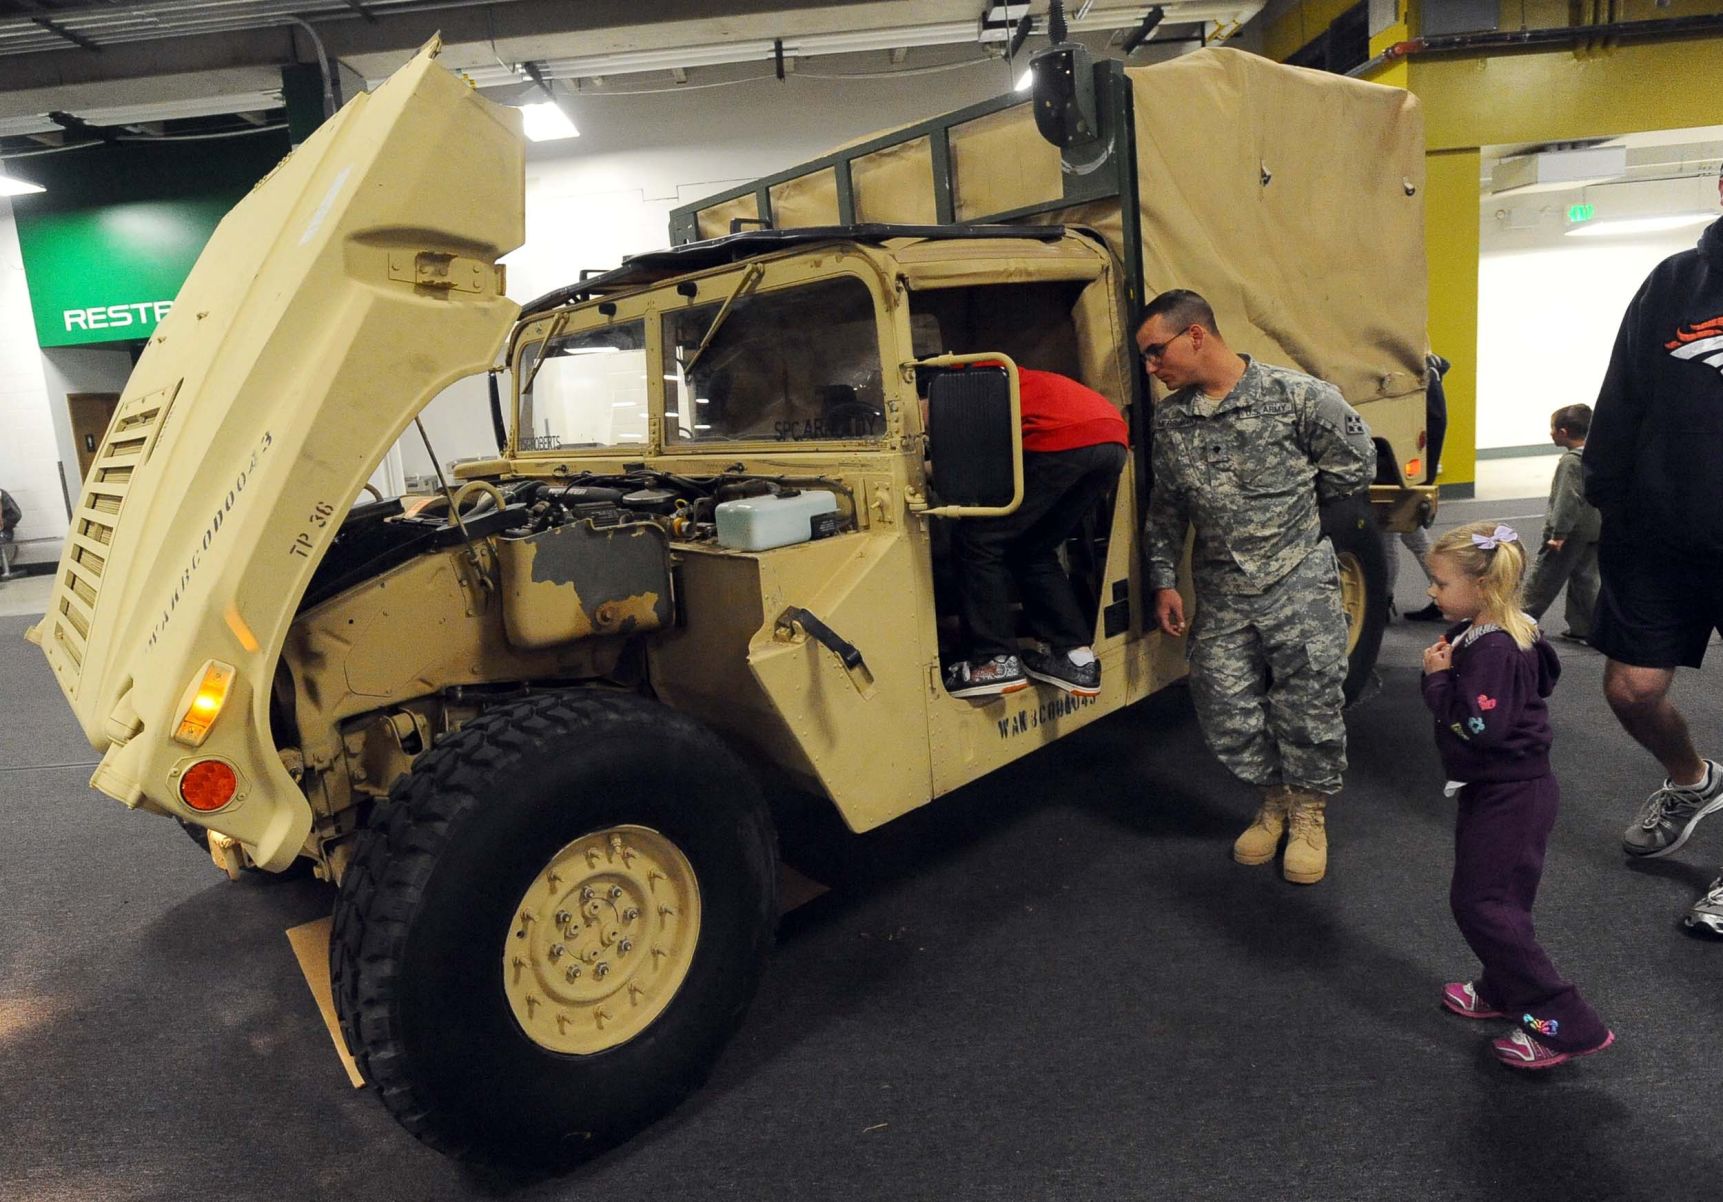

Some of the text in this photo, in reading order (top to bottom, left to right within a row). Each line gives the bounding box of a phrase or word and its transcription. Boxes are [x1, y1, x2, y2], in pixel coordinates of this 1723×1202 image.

[1262, 403, 1287, 414] ARMY
[289, 501, 334, 558] TP 36
